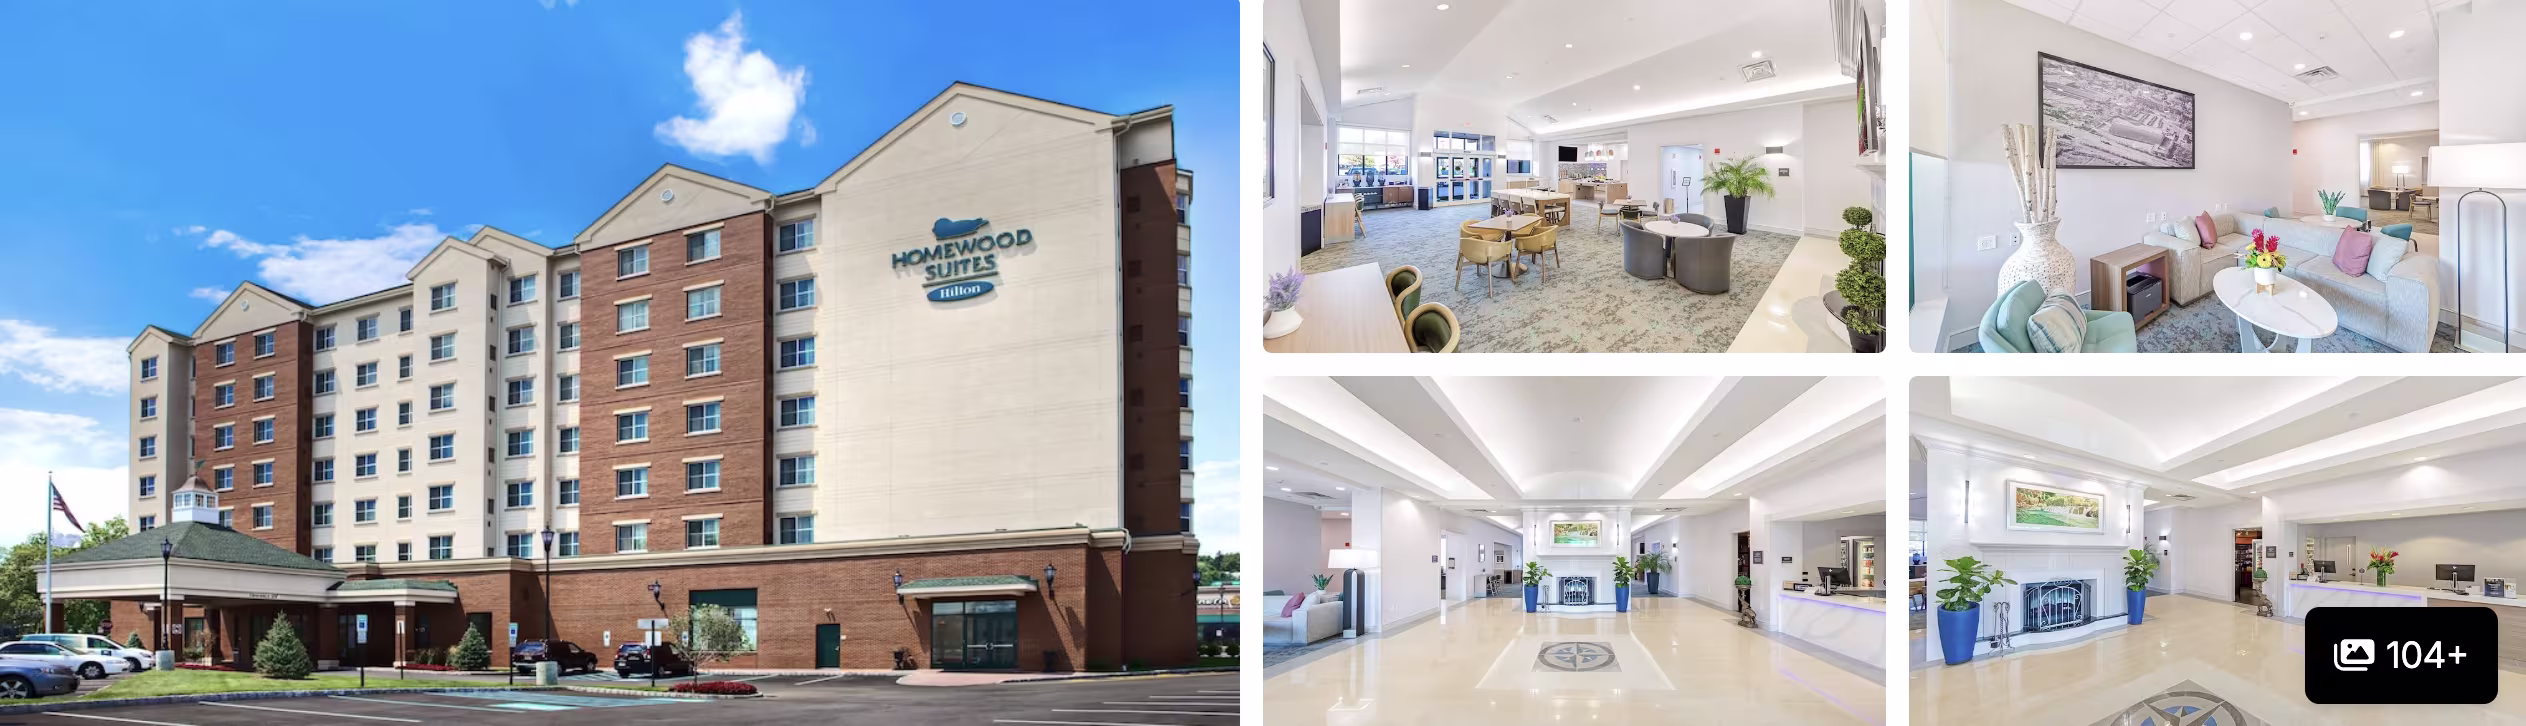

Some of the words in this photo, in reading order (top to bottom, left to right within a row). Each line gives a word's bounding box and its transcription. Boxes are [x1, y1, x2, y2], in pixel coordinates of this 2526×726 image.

[892, 229, 1033, 269] HOMEWOOD
[925, 254, 996, 281] SUITES
[940, 284, 981, 299] Hilton
